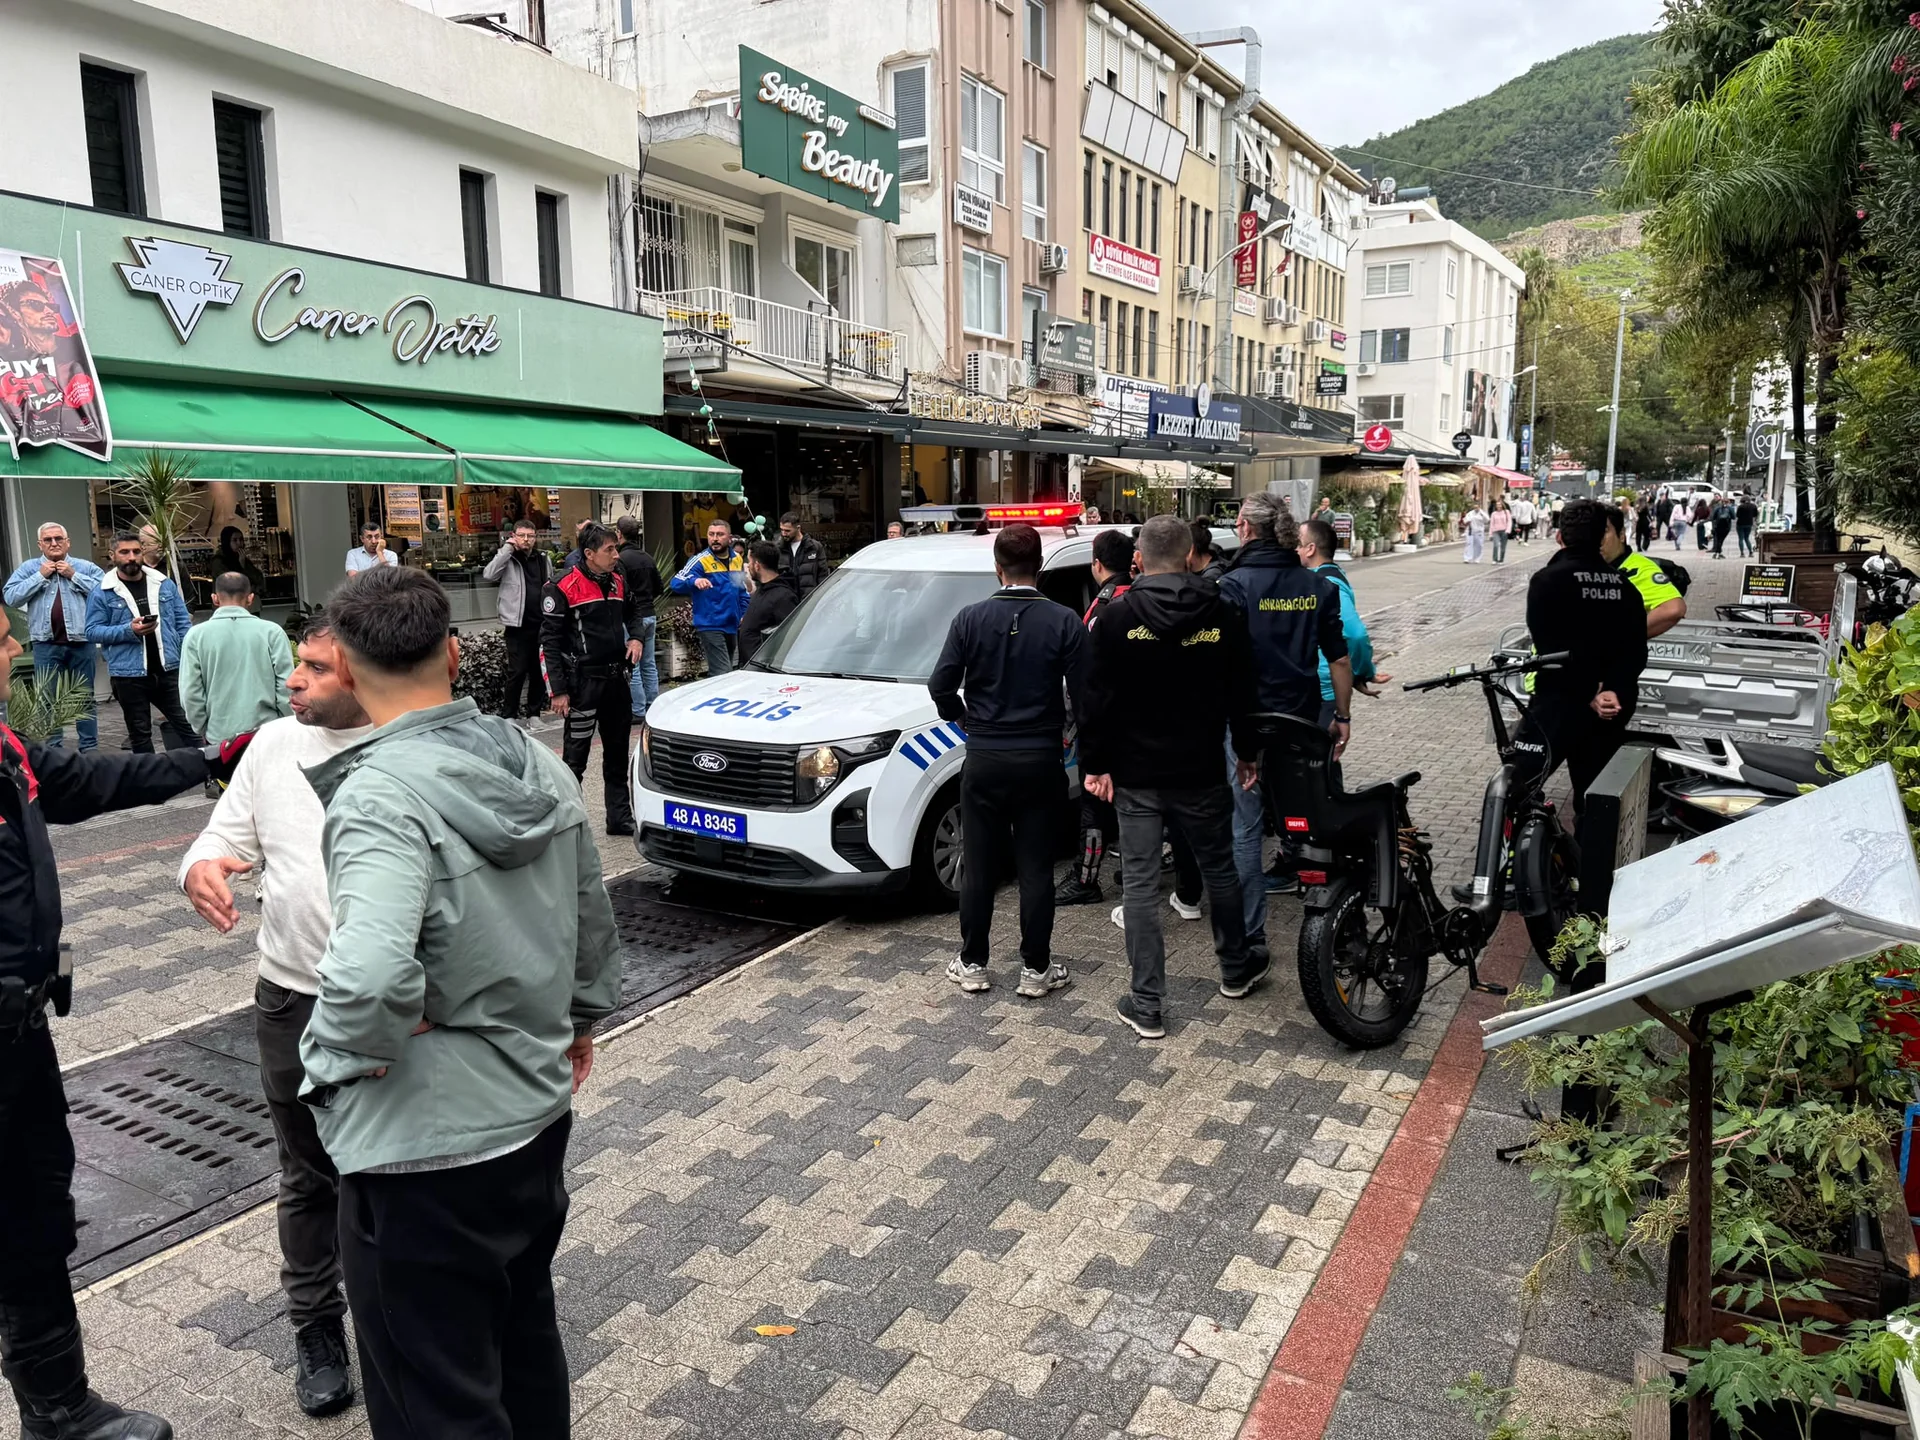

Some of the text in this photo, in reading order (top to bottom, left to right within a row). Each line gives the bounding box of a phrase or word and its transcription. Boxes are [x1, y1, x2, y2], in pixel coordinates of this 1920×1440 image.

[827, 114, 849, 137] my
[802, 131, 894, 207] Beauty
[130, 271, 185, 293] CANER
[252, 267, 502, 365] Caner Optik
[42, 356, 57, 378] 1
[1157, 413, 1241, 442] LEZZET LOKANTASI
[468, 494, 483, 505] BUY
[469, 512, 493, 526] FREE
[1258, 594, 1318, 612] ANKARAGÜCÜ
[690, 697, 802, 721] POLİS
[698, 755, 720, 769] Ford
[672, 808, 737, 834] 48 A 8345
